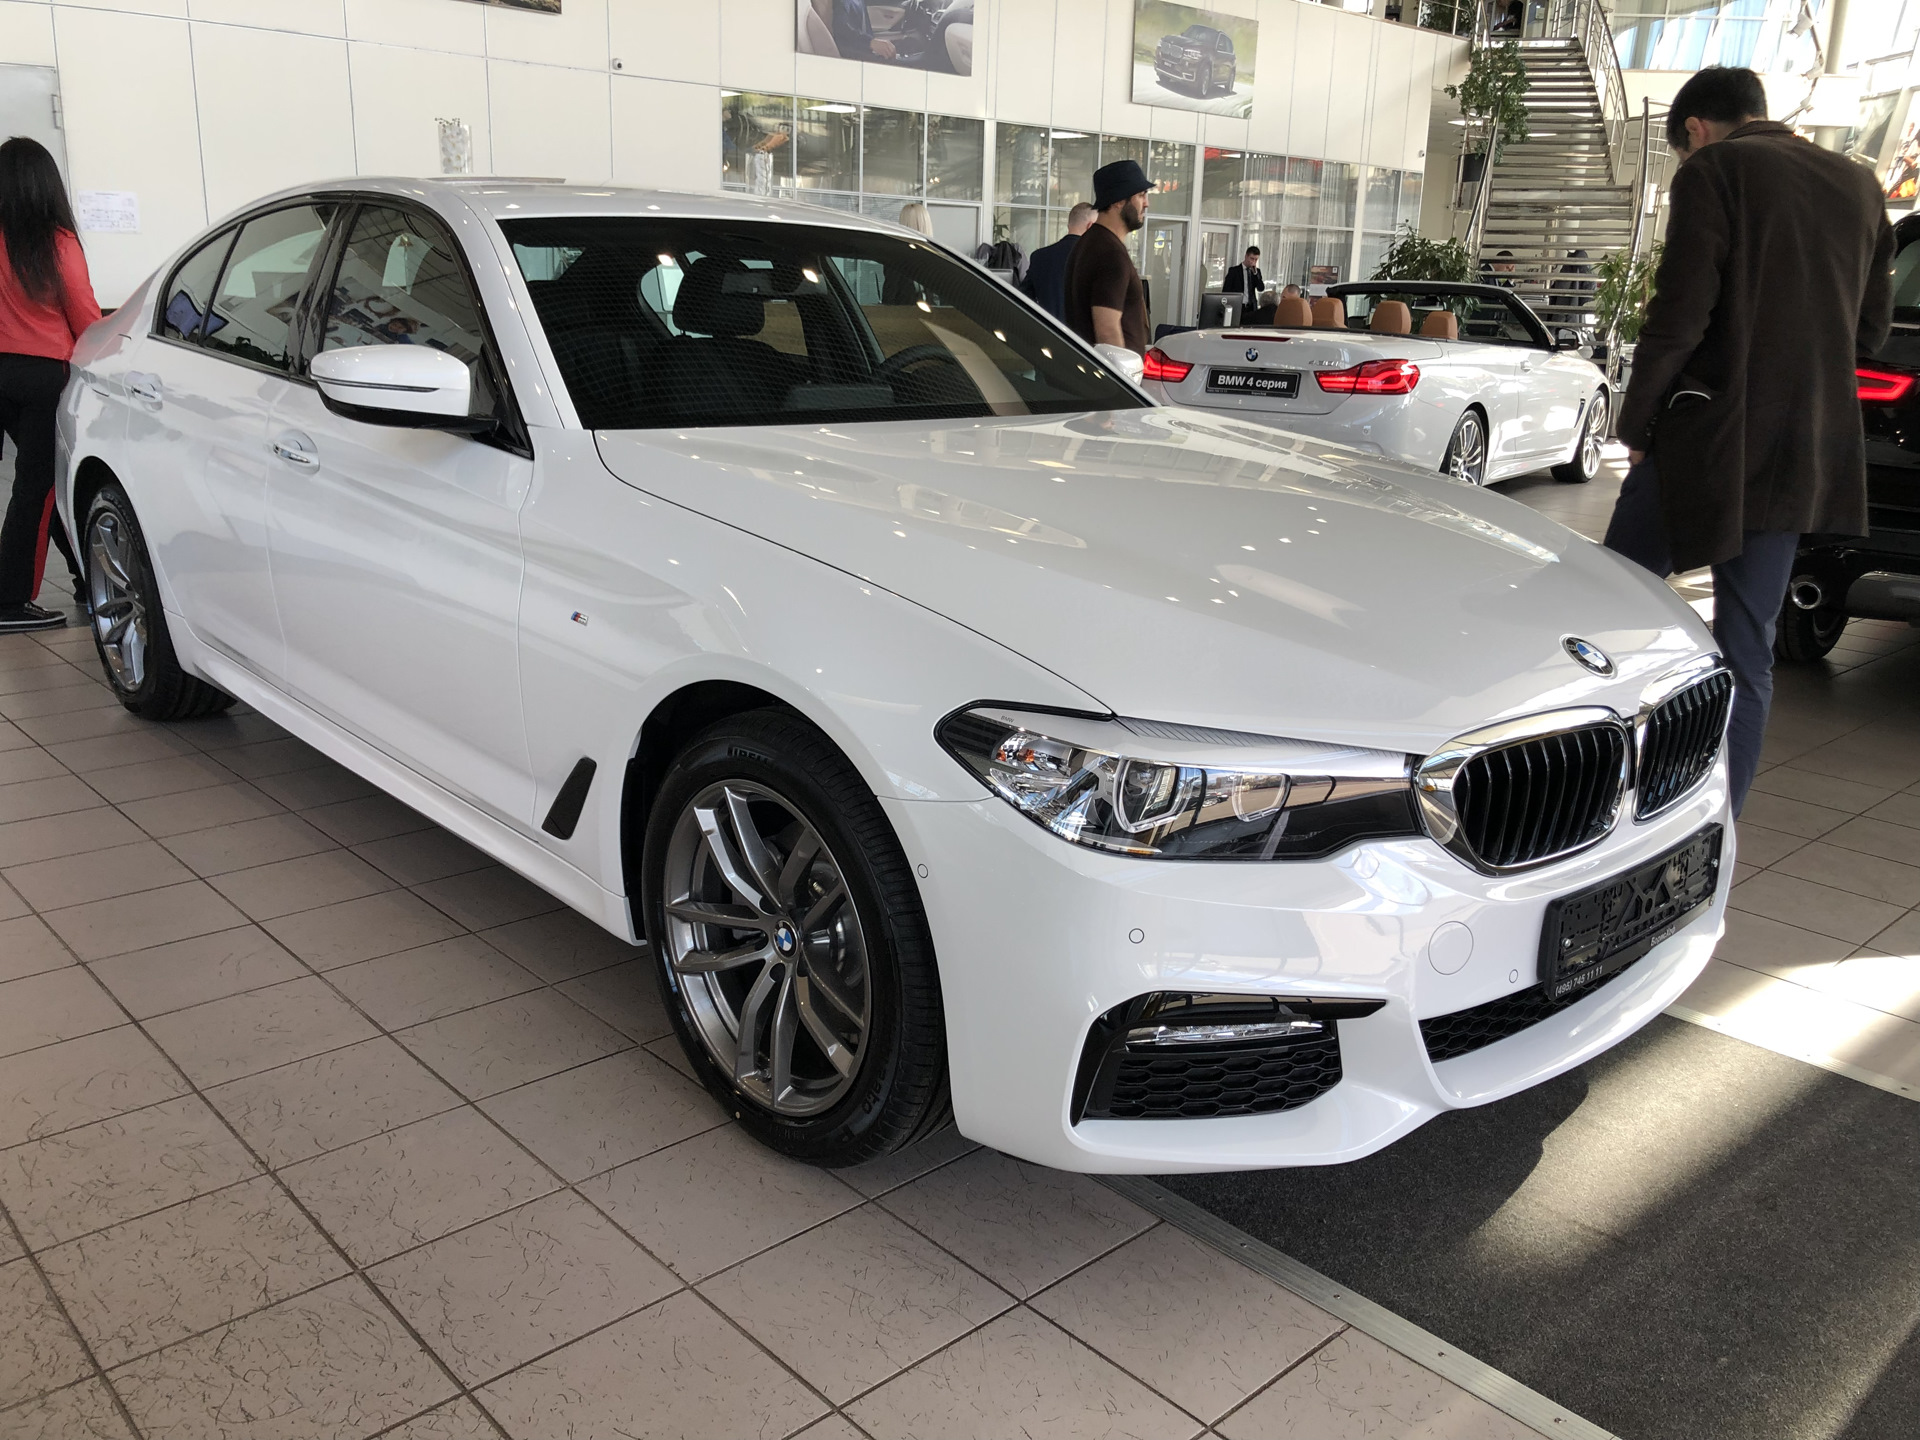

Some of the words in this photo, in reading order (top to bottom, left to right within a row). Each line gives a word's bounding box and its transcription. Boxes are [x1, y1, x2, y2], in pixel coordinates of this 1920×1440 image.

[1217, 374, 1246, 386] BMW
[1246, 376, 1254, 387] 4
[1255, 379, 1288, 390] серия
[1556, 979, 1572, 997] (495)
[1573, 973, 1586, 988] 745
[1586, 969, 1594, 981] 11
[1595, 964, 1603, 977] 11
